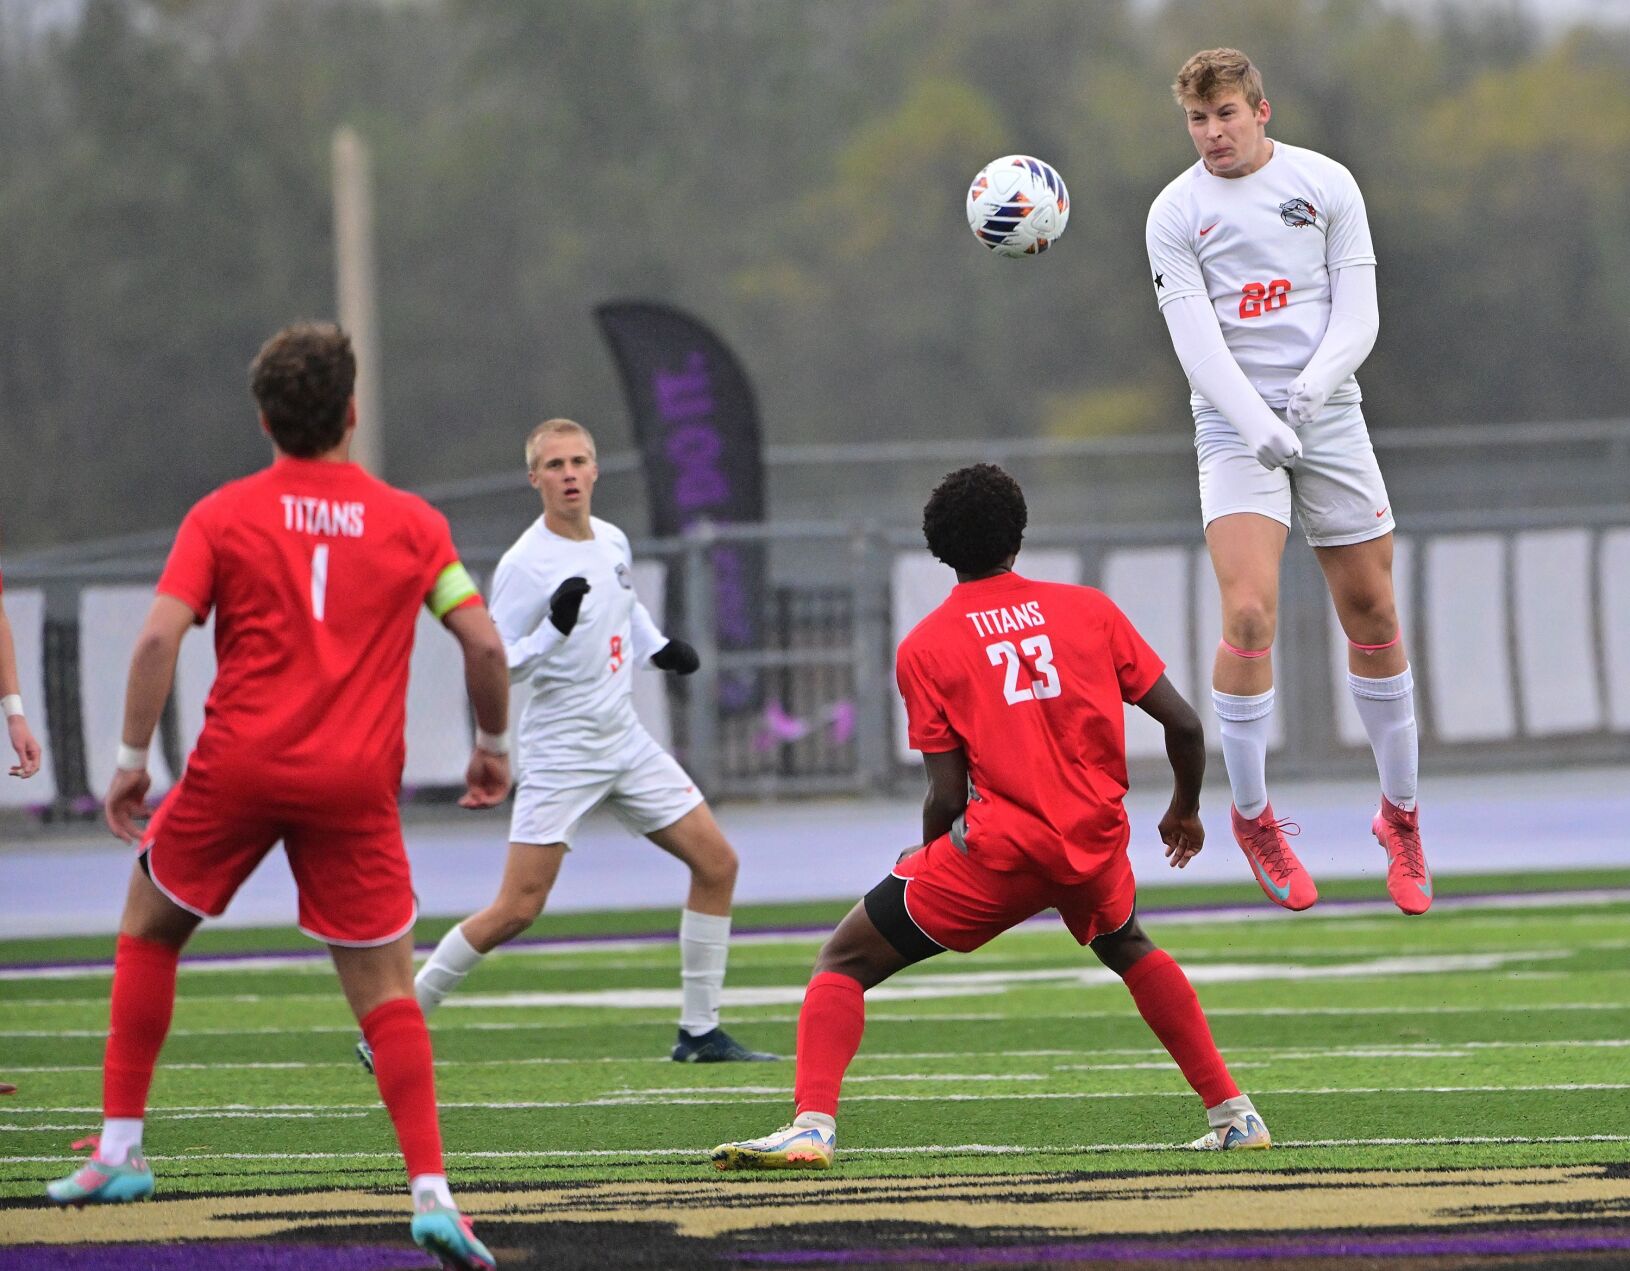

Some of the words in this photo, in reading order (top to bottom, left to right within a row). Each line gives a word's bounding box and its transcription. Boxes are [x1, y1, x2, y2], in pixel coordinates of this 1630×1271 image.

[1239, 279, 1291, 319] 20
[281, 494, 365, 537] TITANS
[311, 543, 329, 622] 1
[966, 600, 1045, 637] TITANS
[985, 634, 1061, 706] 23
